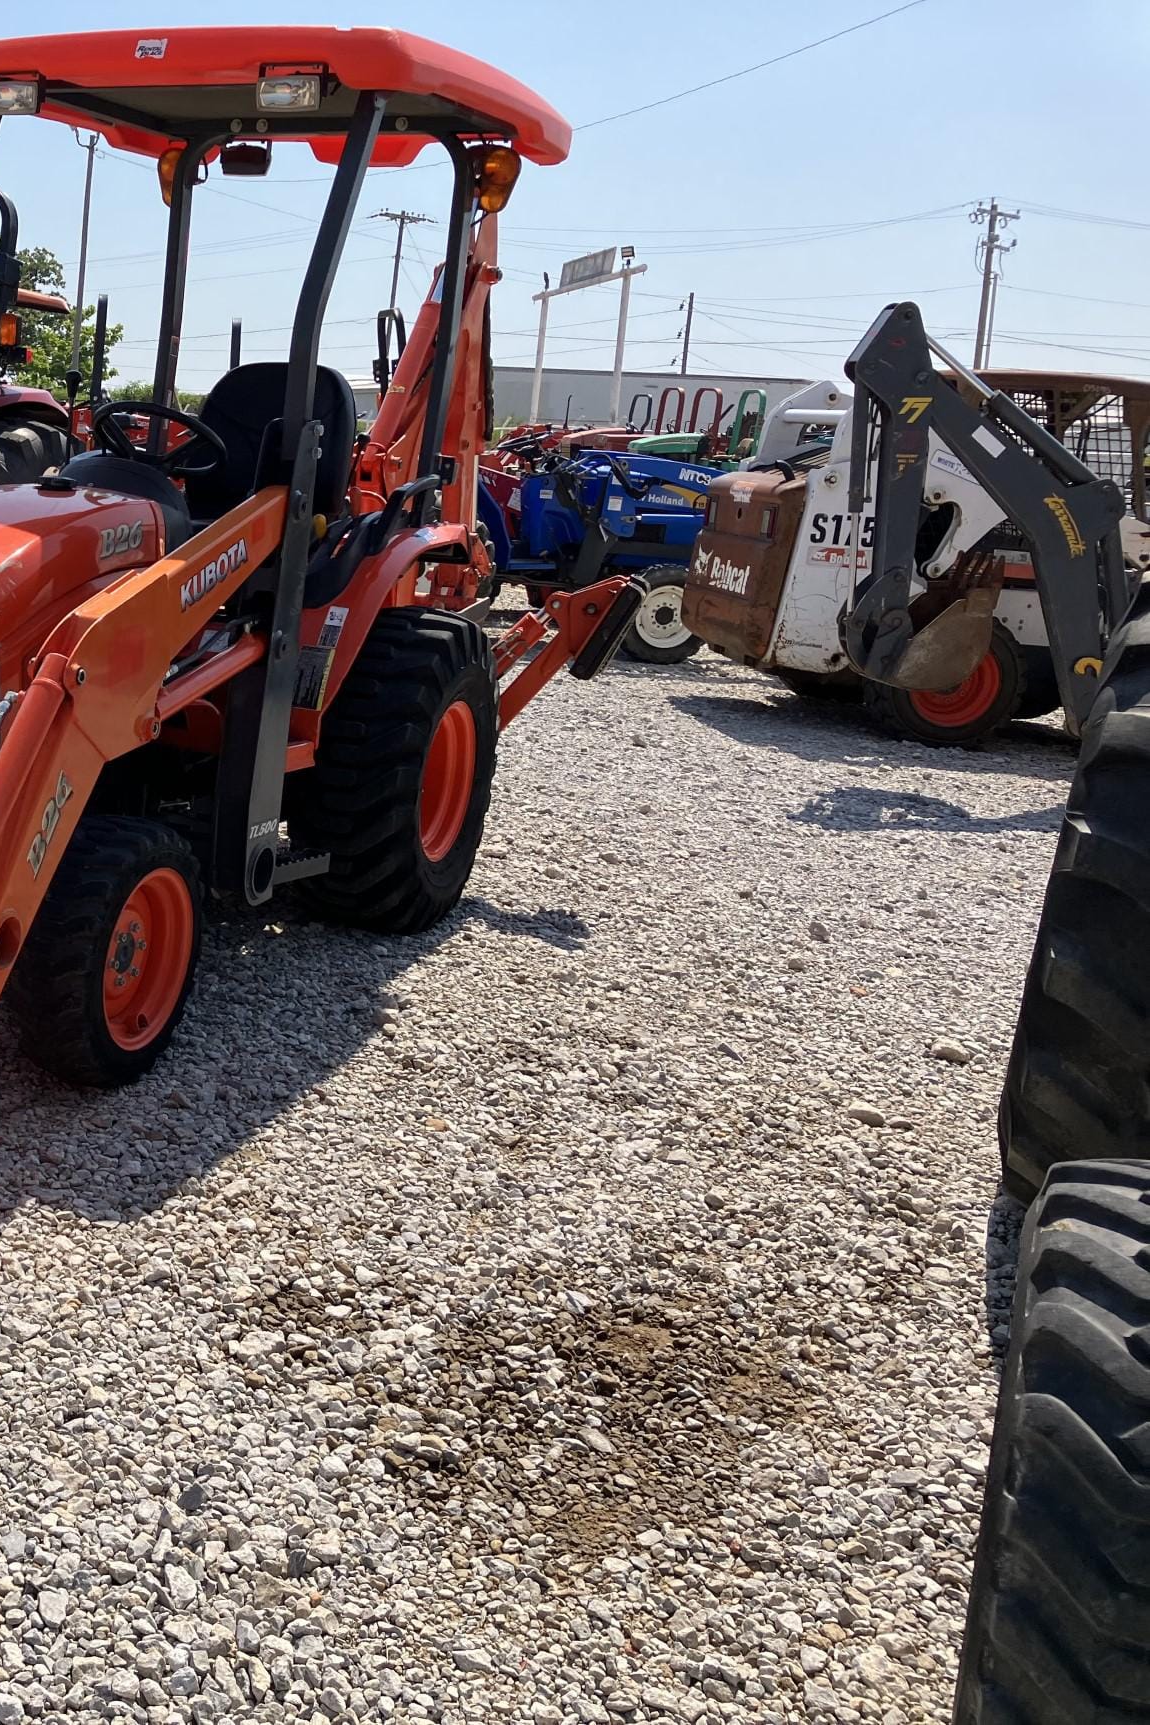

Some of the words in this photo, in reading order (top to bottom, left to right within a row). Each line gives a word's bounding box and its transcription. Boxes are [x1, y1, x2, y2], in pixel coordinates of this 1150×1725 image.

[647, 493, 685, 506] Holland
[100, 520, 145, 559] B26
[180, 537, 248, 612] KUBOTA
[709, 556, 751, 595] Bobcat
[829, 552, 867, 567] Bobat
[26, 769, 73, 880] B26
